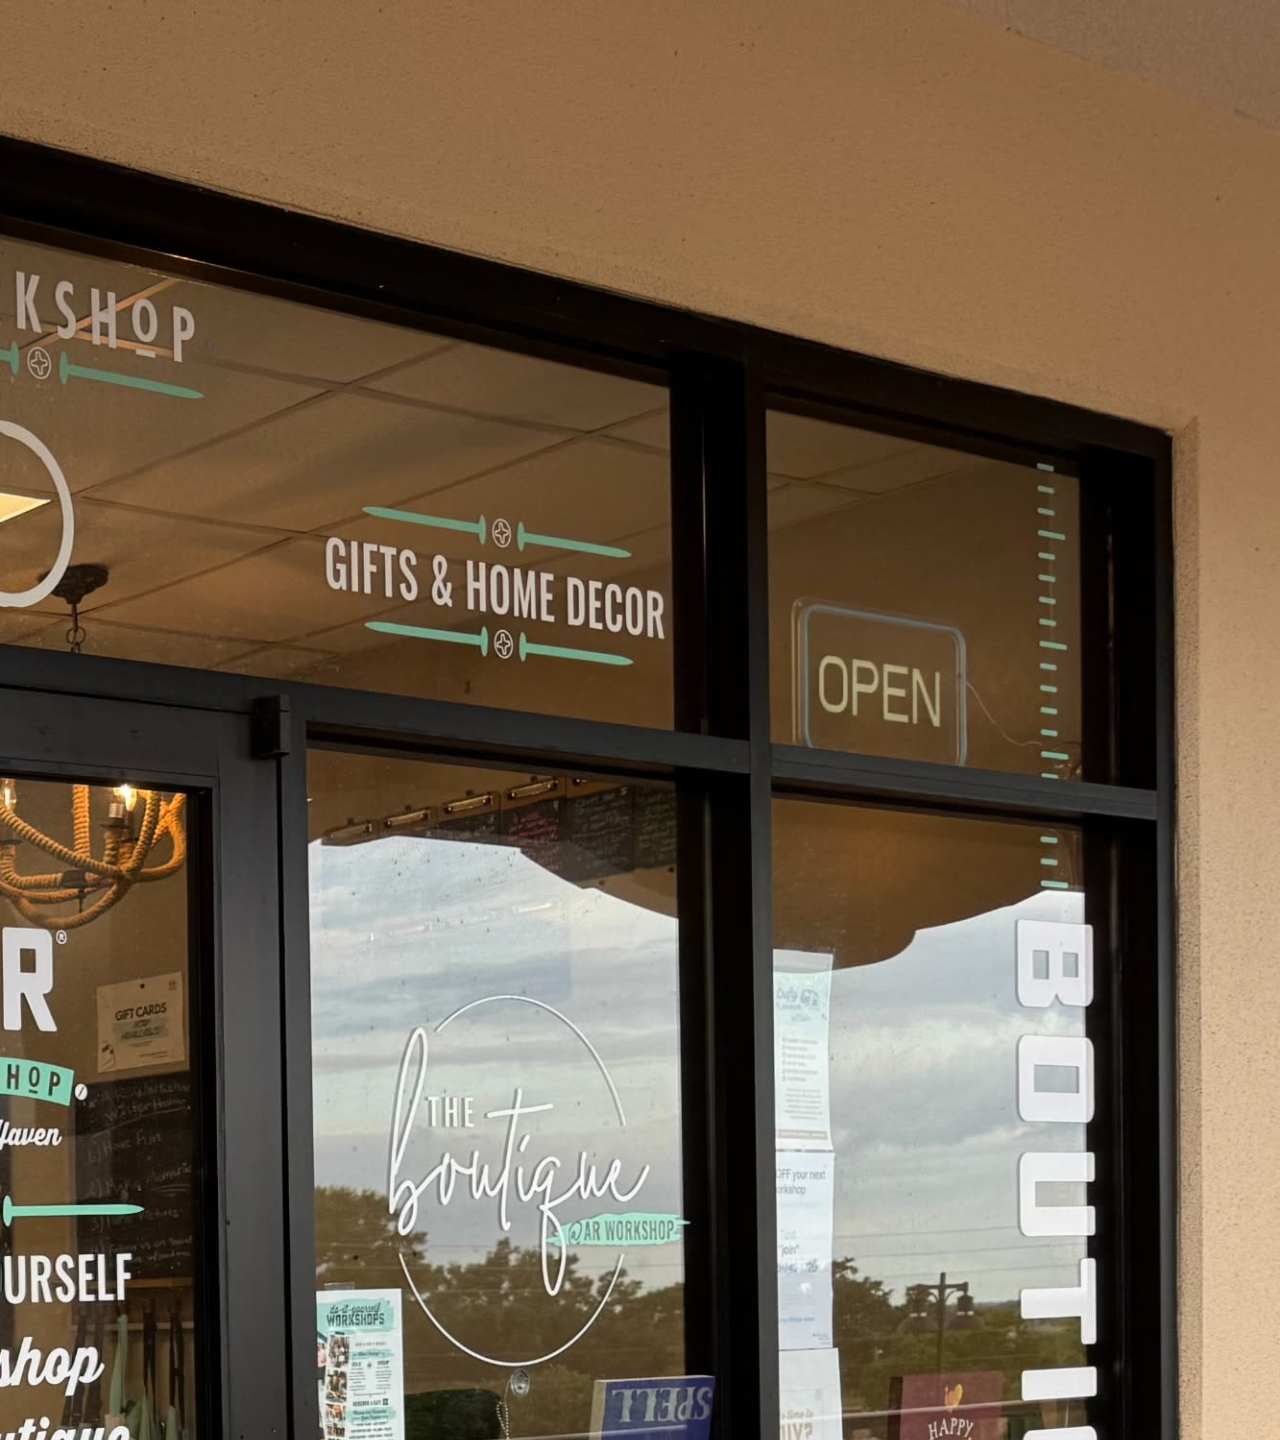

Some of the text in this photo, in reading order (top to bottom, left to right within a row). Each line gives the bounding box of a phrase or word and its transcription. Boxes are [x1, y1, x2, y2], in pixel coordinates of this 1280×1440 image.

[325, 535, 666, 641] GIFTS & HOME DECOR
[817, 653, 941, 727] OPEN
[114, 1001, 168, 1022] GIFT CARDS
[427, 1096, 475, 1128] THE
[388, 1027, 651, 1297] boutique
[566, 1217, 677, 1244] @AR WORKSHOP
[326, 1312, 386, 1328] WORKSHOPS
[611, 1386, 714, 1423] SPELL
[927, 1417, 974, 1440] HAPPY
